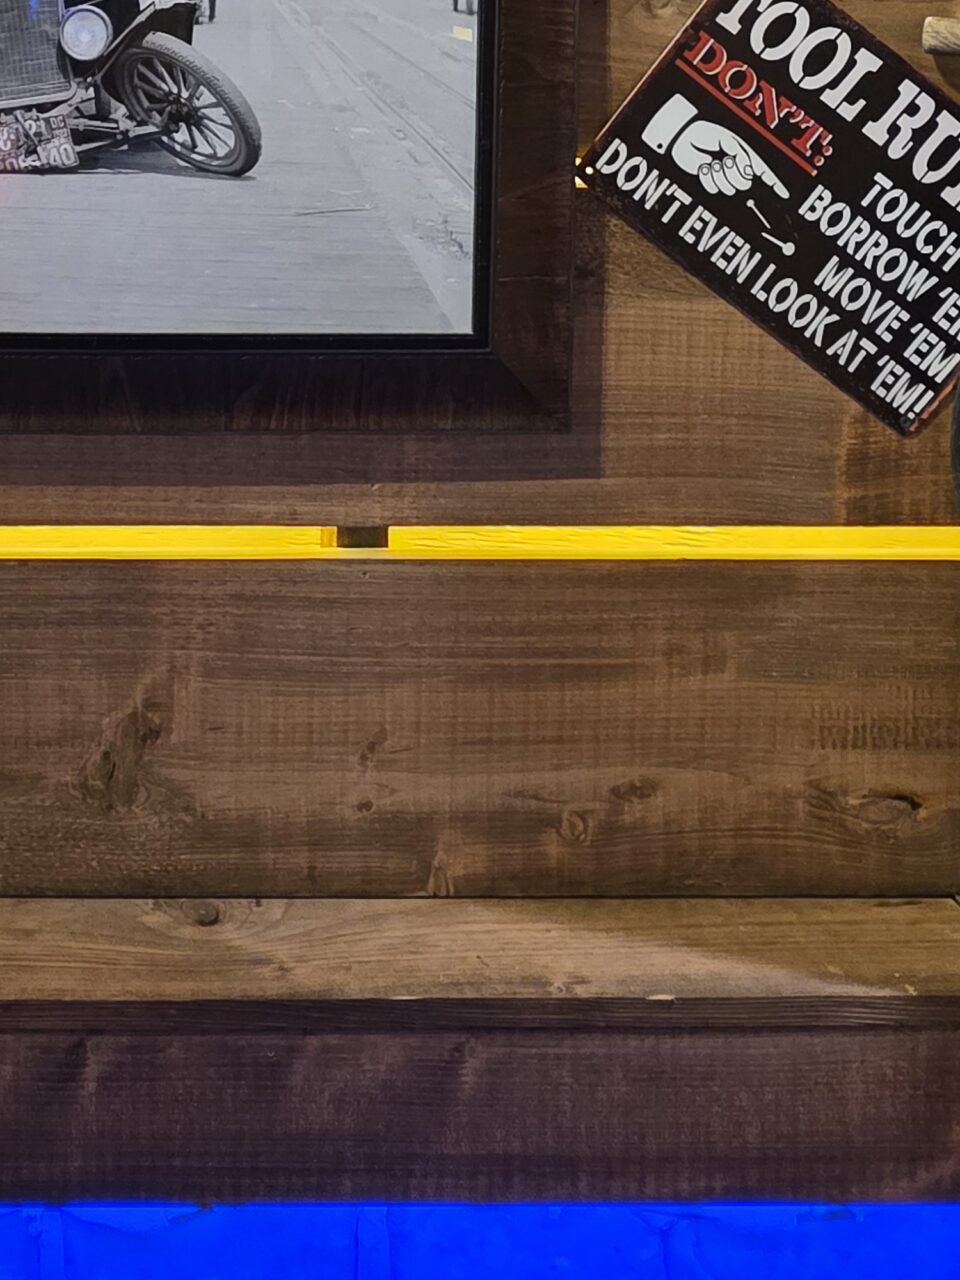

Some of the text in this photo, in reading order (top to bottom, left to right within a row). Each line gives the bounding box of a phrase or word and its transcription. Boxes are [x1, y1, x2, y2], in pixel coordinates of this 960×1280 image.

[595, 137, 693, 224] DON'T
[678, 205, 762, 284] EVEN
[750, 262, 840, 347] LOOK
[825, 329, 879, 373] AT
[798, 184, 939, 302] BORROW
[860, 172, 960, 272] TOUCH
[814, 255, 911, 343] MOVE
